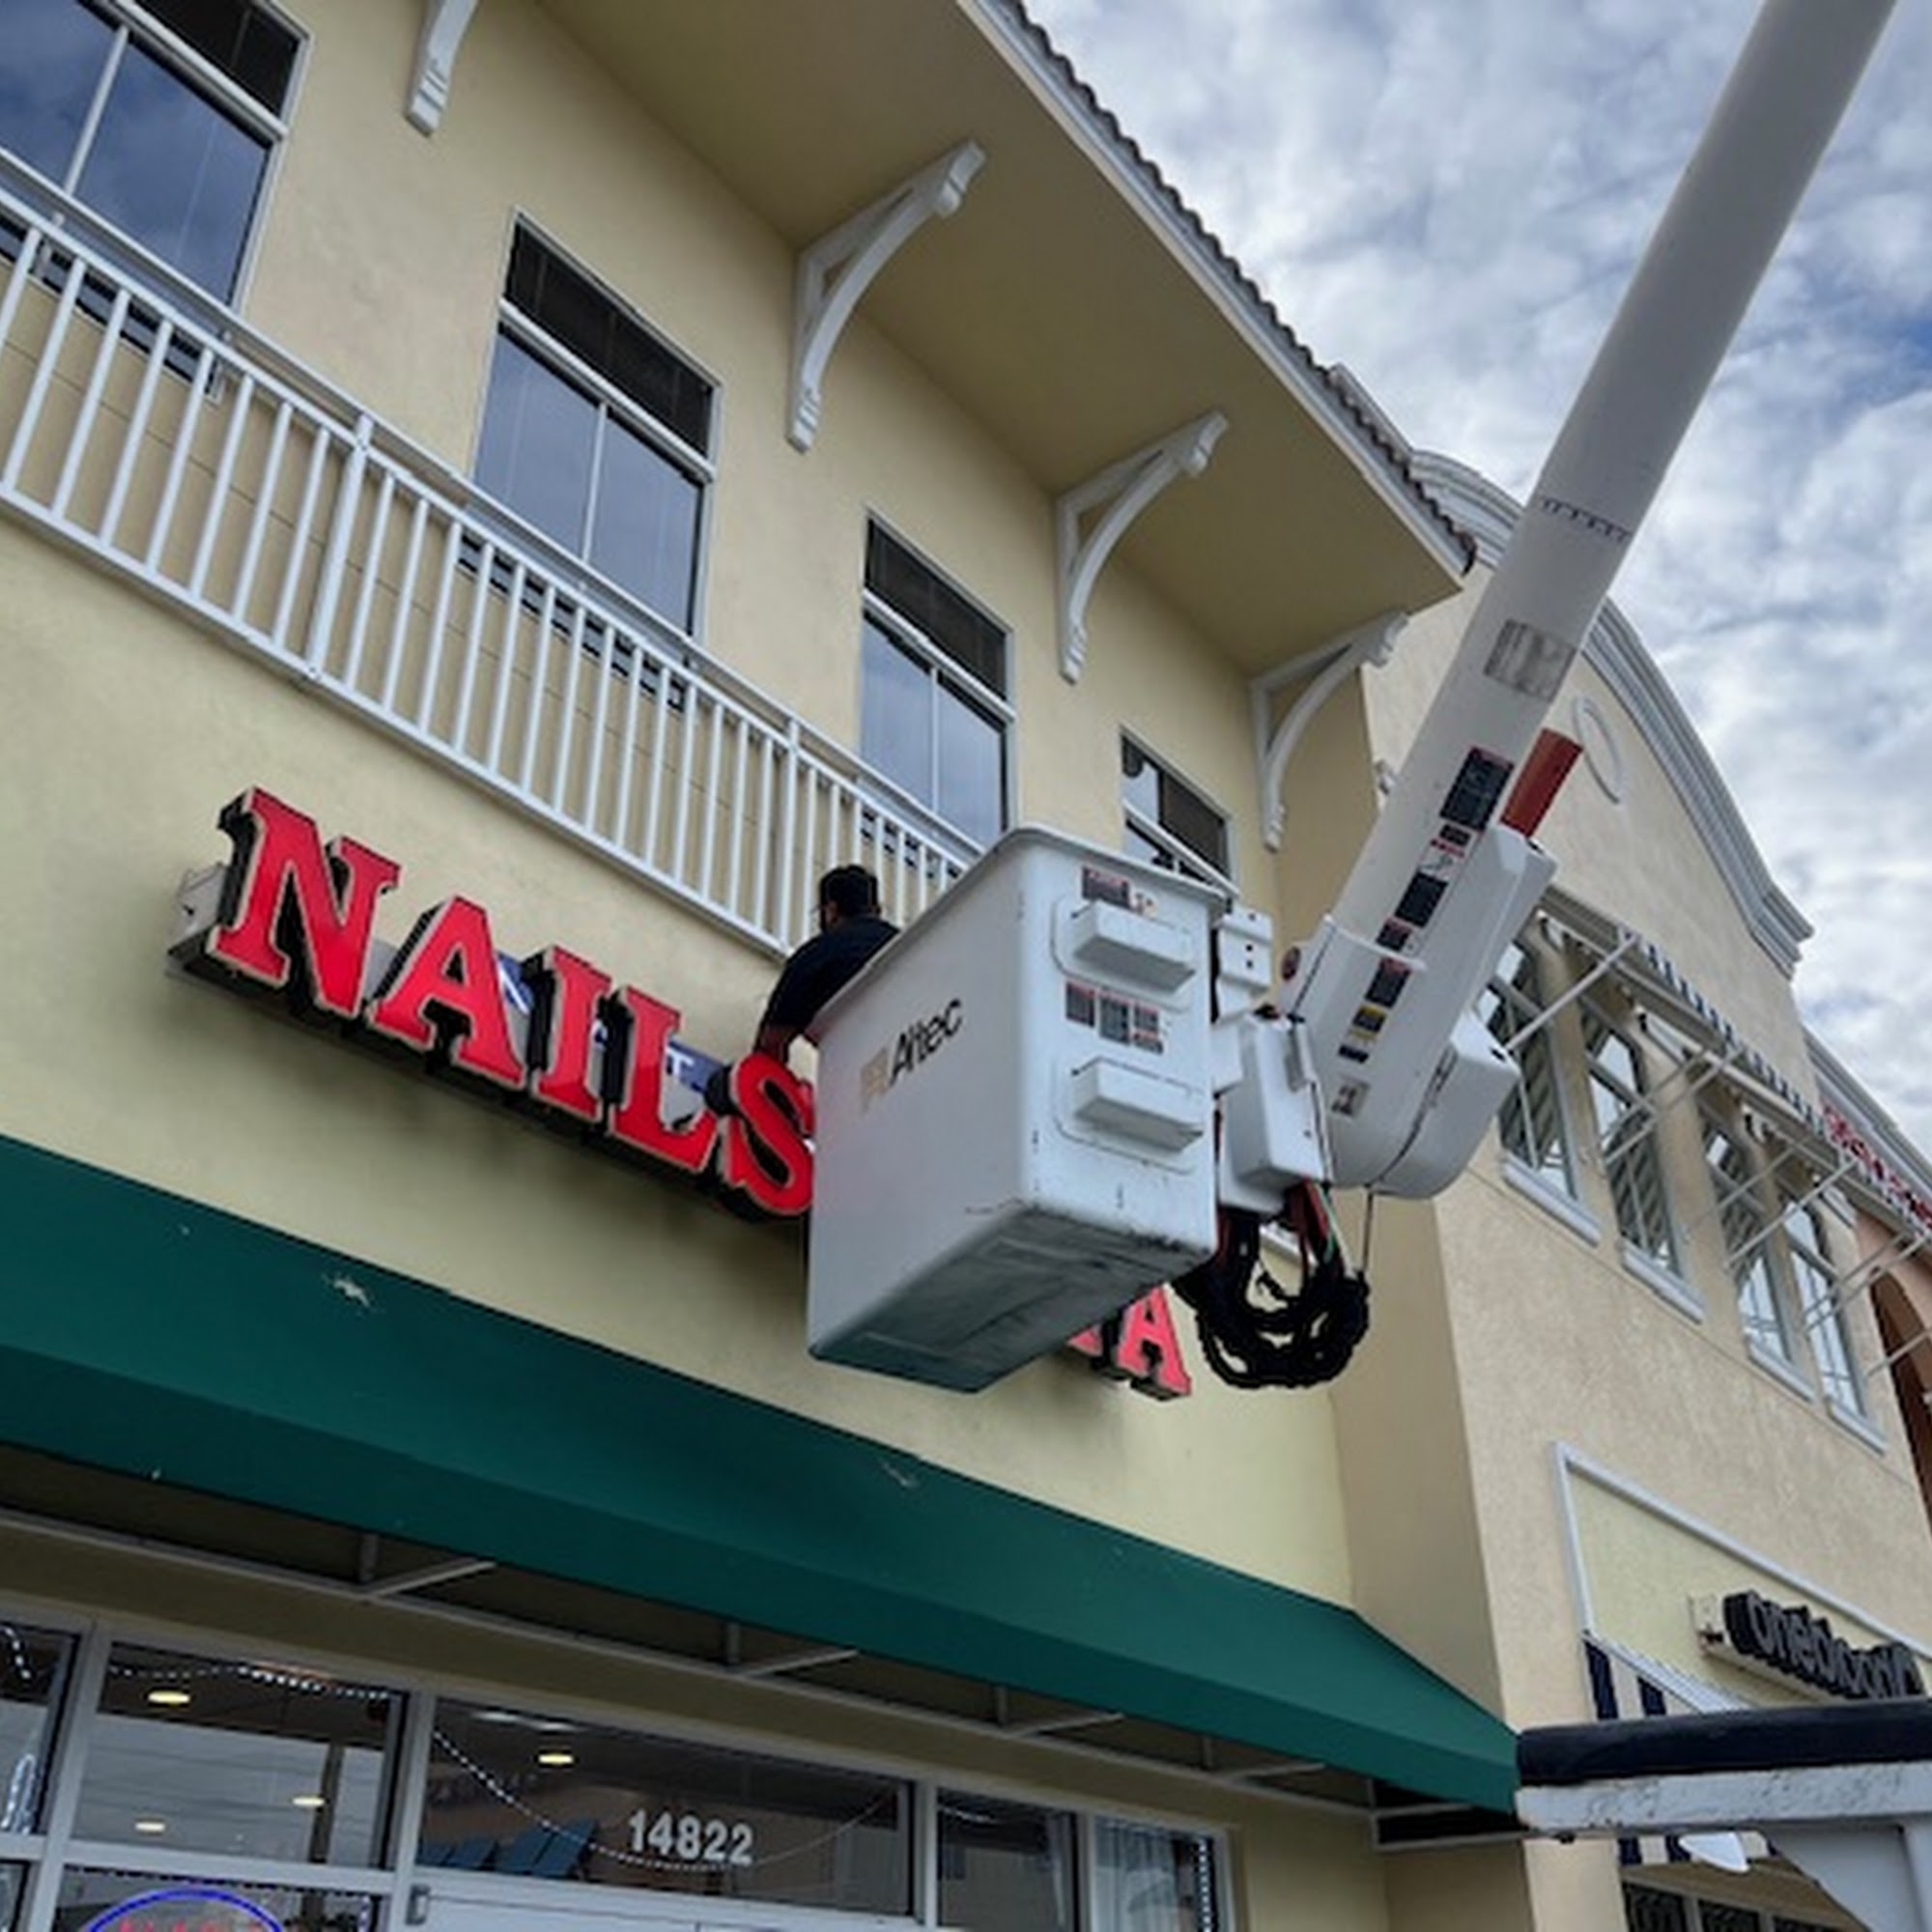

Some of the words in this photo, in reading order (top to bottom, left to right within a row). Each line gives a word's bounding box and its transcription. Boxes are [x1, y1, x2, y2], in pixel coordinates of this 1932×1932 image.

[207, 786, 813, 1217] NAILS
[889, 998, 962, 1088] Altec
[629, 1808, 753, 1866] 14822
